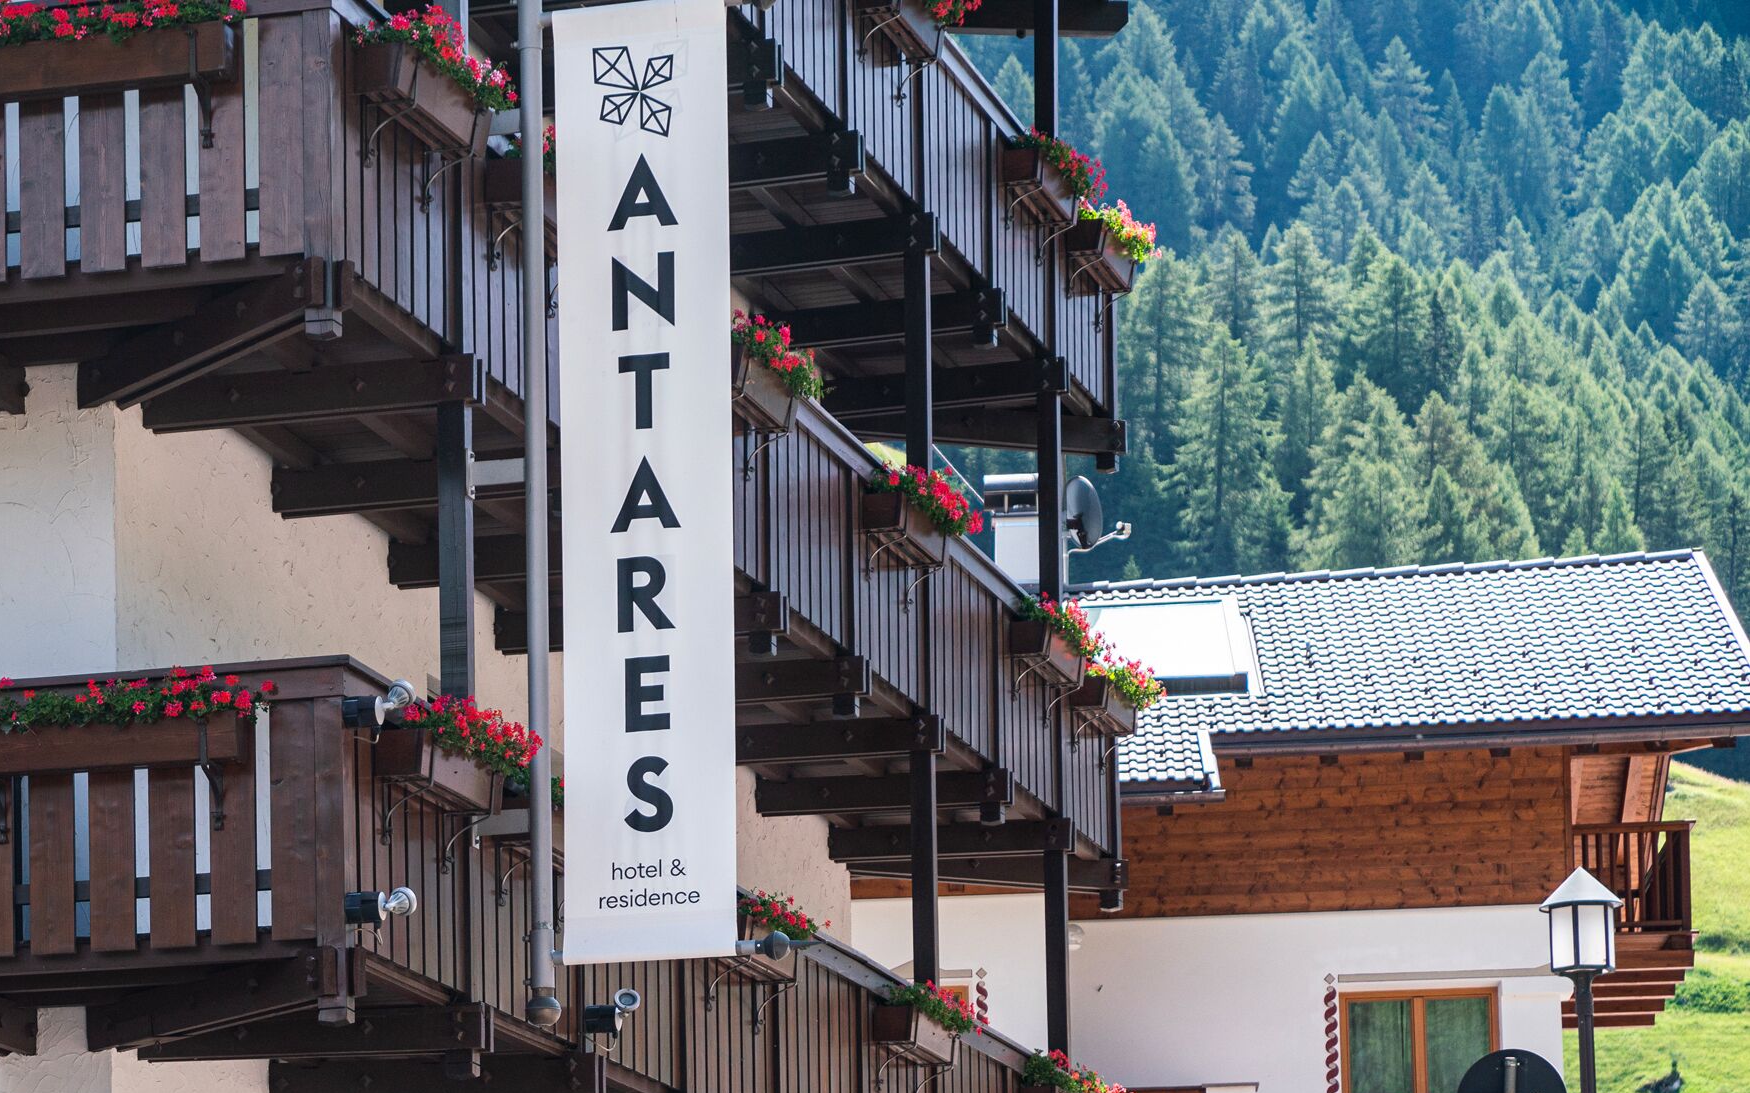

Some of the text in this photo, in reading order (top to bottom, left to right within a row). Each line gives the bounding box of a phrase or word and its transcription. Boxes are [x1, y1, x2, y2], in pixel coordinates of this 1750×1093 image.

[606, 152, 683, 834] ANTARES
[611, 858, 687, 881] hotel &
[598, 887, 701, 910] residence
